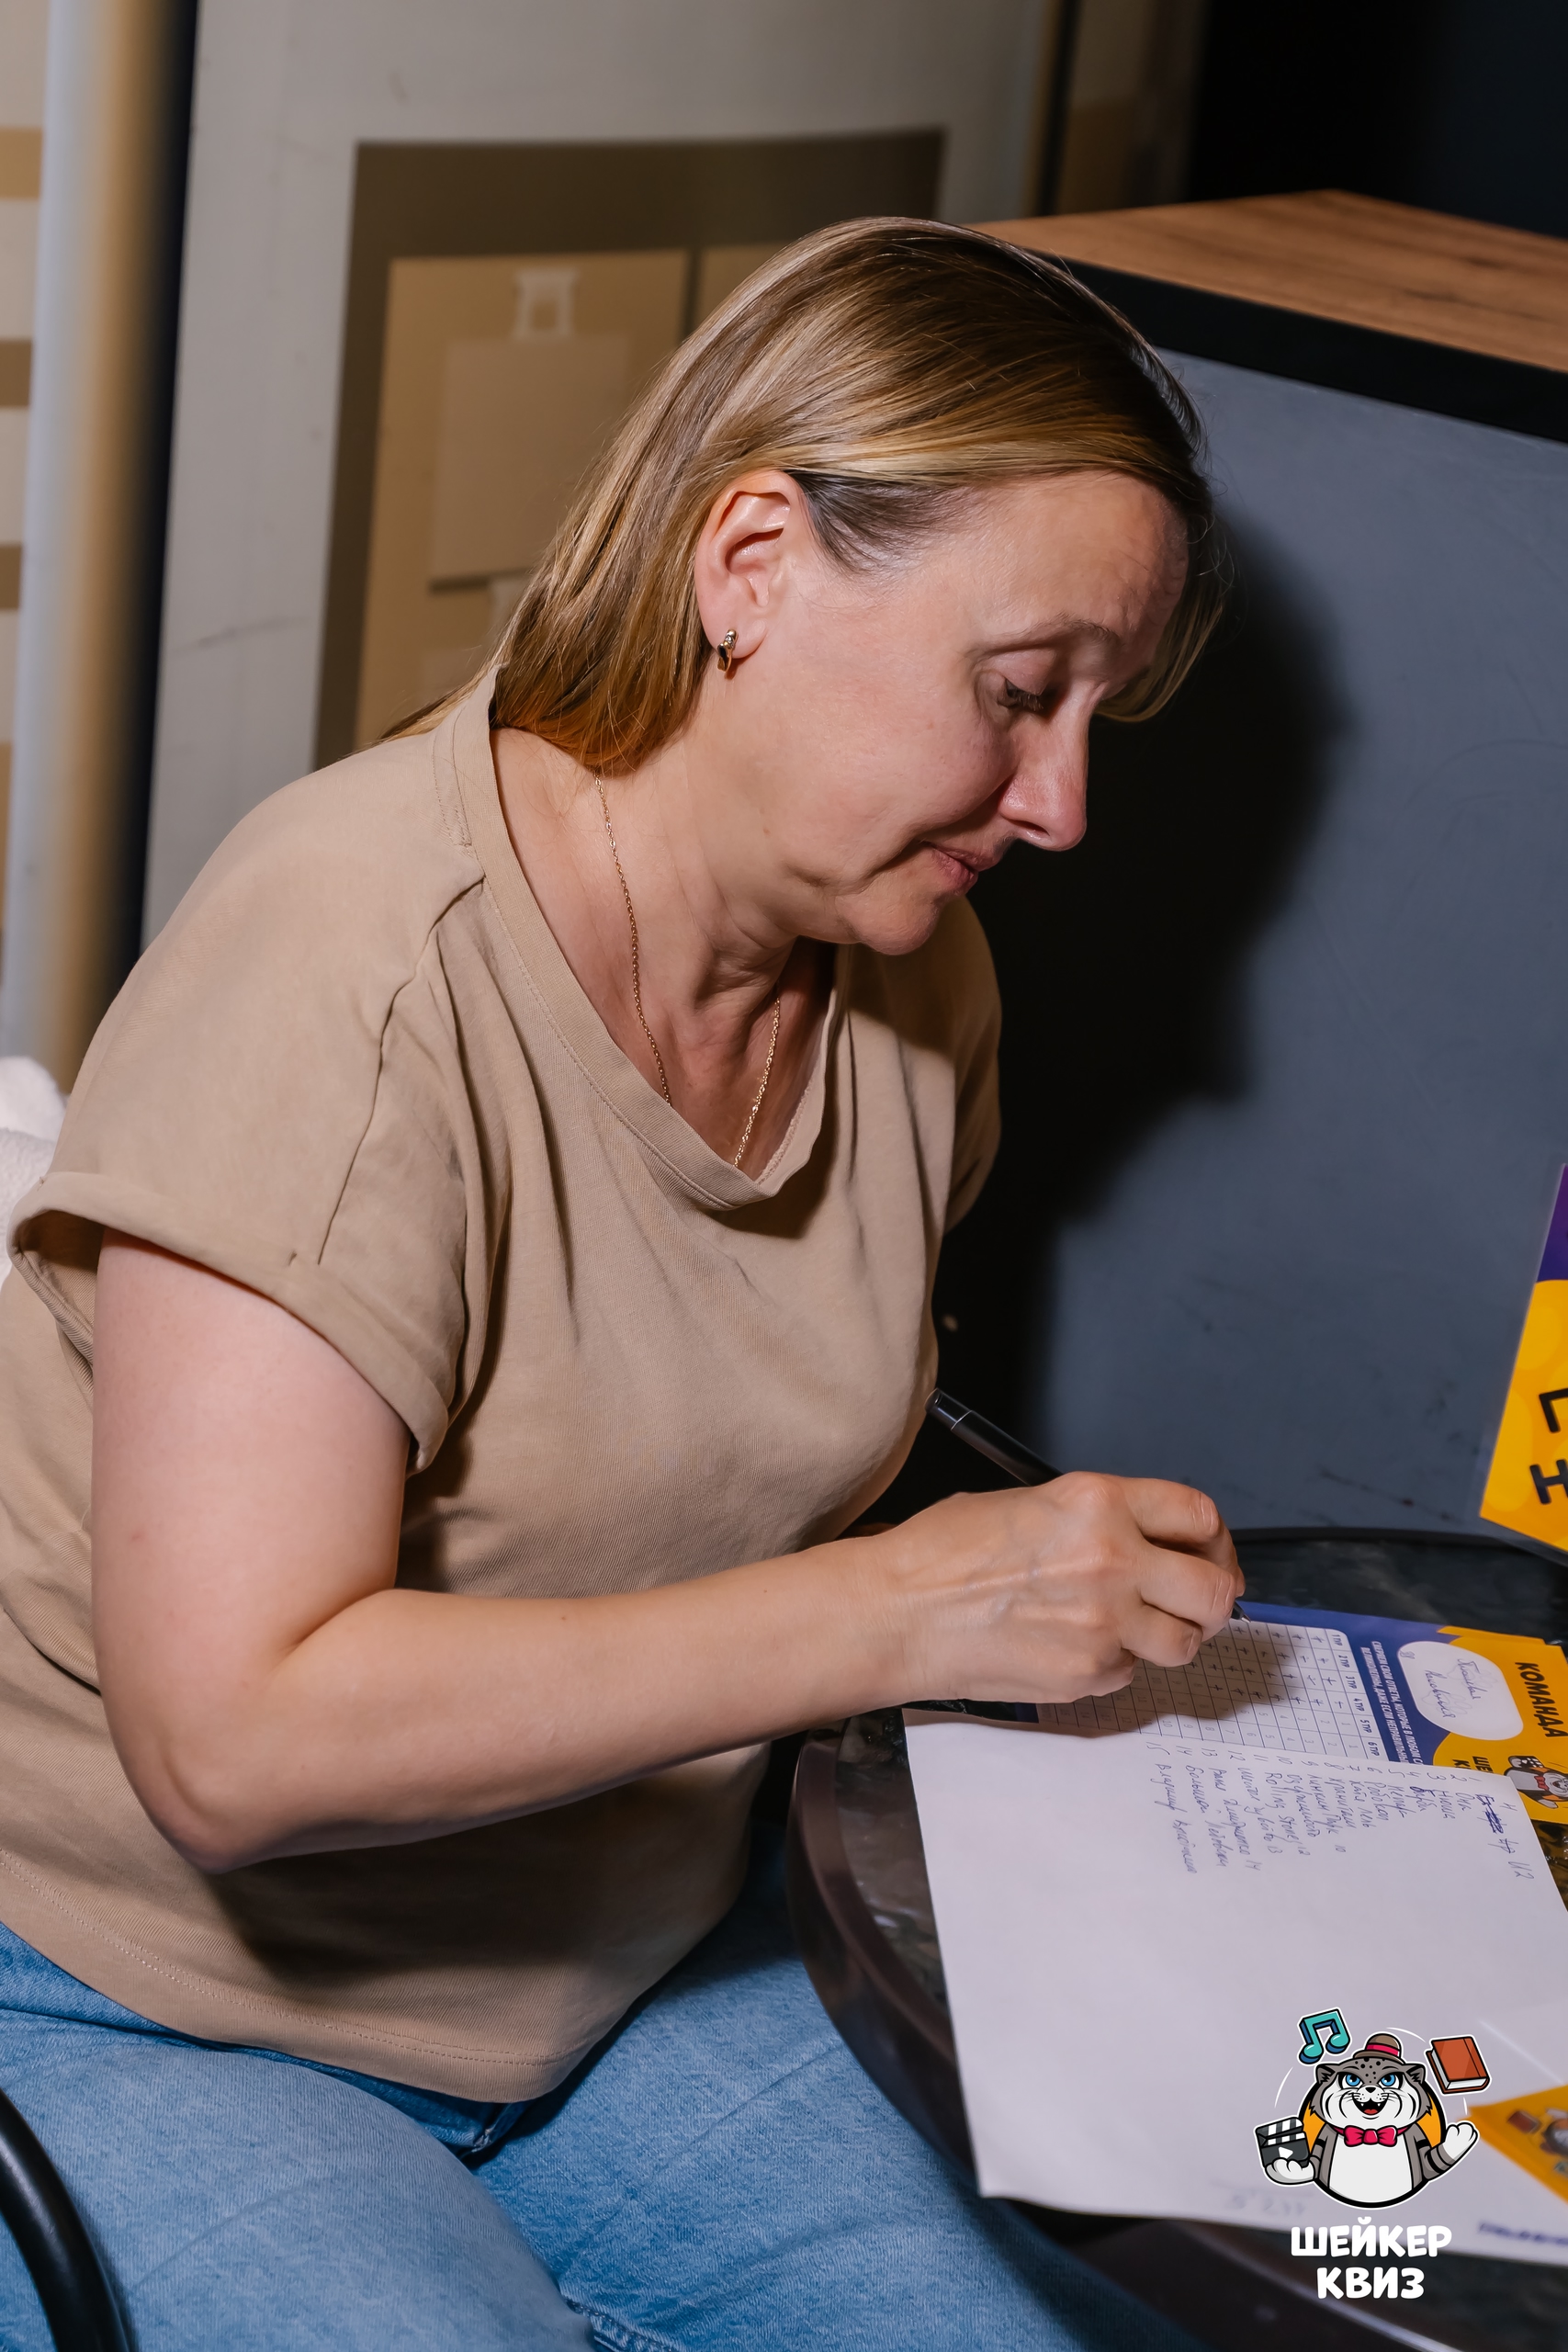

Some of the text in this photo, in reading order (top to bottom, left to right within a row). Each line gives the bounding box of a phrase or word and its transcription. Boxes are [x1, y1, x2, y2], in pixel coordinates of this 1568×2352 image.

[1333, 1638, 1343, 1646] ТУР
[1339, 1658, 1349, 1668] ТУР
[1380, 1665, 1394, 1679] СВОИ
[1348, 1679, 1357, 1689] ТУР
[1373, 1688, 1390, 1704] ДАЖЕ
[1385, 1680, 1401, 1702] ОТВЕТЫ,
[1515, 1662, 1568, 1737] КОМАНДА
[1355, 1702, 1365, 1712] ТУР
[1380, 1704, 1394, 1720] ЕСЛИ
[1393, 1703, 1410, 1729] КОТОРЫЕ
[1361, 1724, 1372, 1733] ТУР
[1387, 1720, 1409, 1763] НЕПРАВИЛЬНЫ
[1405, 1735, 1422, 1758] ЛЮБОМ
[1146, 1742, 1170, 1755] 15
[1176, 1746, 1192, 1756] 14
[1370, 1747, 1380, 1757] ТУР
[1253, 1754, 1269, 1762] 11
[1276, 1756, 1293, 1765] 10
[1452, 1759, 1472, 1770] К
[1472, 1756, 1495, 1773] ШЕ
[1324, 1762, 1345, 1770] 8
[1388, 1769, 1404, 1778] 5
[1227, 1750, 1246, 1760] 12
[1267, 1846, 1283, 1854] 13
[1436, 1790, 1455, 1819] Нюша
[1201, 1748, 1218, 1757] 13
[1246, 1860, 1263, 1871] 14
